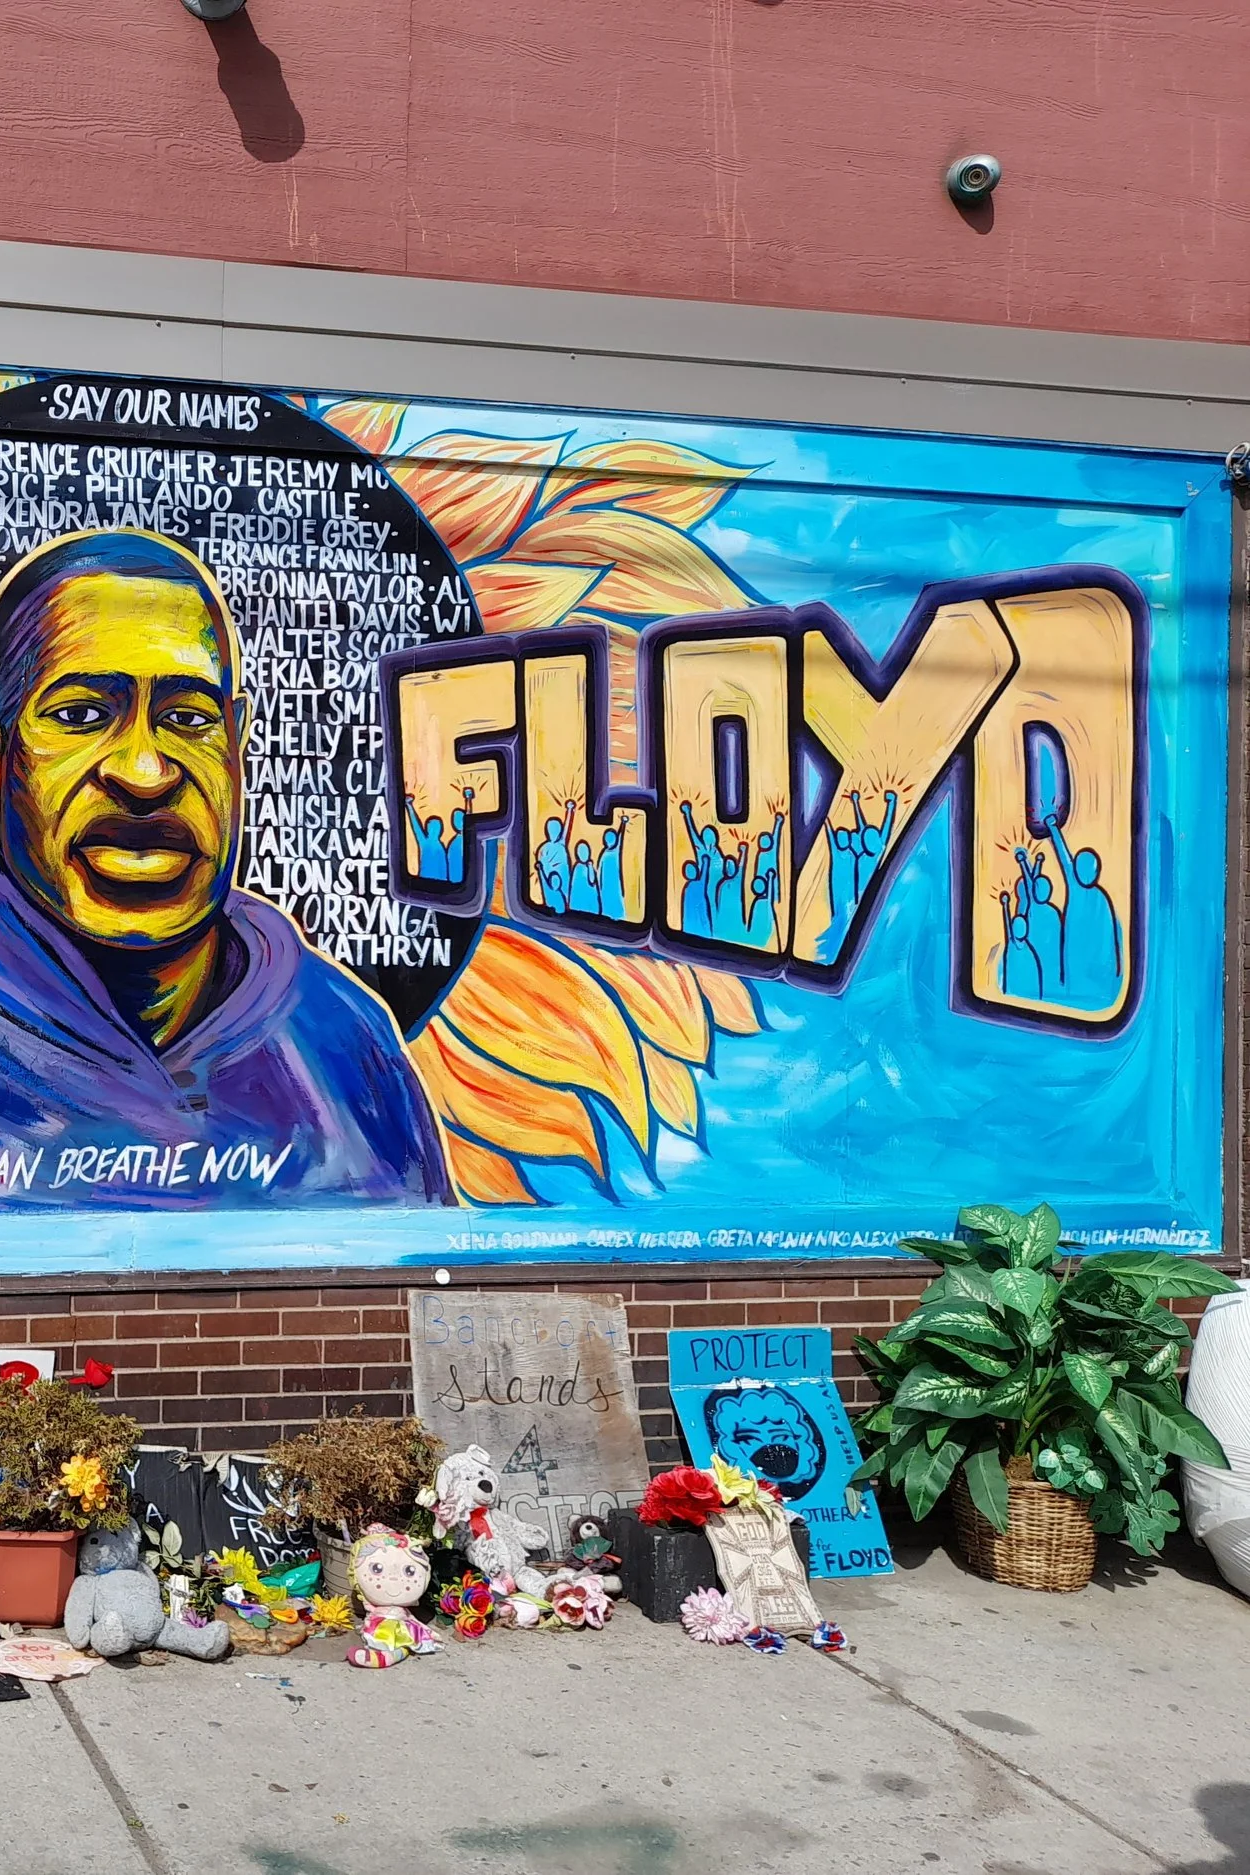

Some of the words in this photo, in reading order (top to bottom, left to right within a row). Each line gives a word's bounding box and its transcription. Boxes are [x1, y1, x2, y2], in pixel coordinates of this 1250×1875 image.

[49, 384, 113, 423] SAY
[115, 386, 172, 427] OUR
[180, 393, 261, 431] NAMES
[87, 446, 217, 486] CRUTCHER
[227, 455, 339, 490] JEREMY
[86, 475, 232, 511] PHILANDO
[257, 487, 361, 521] CASTILE
[102, 502, 189, 537] JAMES
[211, 511, 319, 545] FREDDIE
[322, 520, 391, 551] GREY
[192, 537, 306, 569] TERRANCE
[305, 545, 417, 575] FRANKLIN
[215, 565, 330, 600] BREONNA
[330, 572, 425, 606] TAYLOR
[434, 575, 470, 606] AL
[230, 595, 344, 631] SHANTEL
[348, 601, 421, 633] DAVIS
[432, 604, 471, 633] WI
[236, 626, 344, 661] WALTER
[241, 657, 317, 689] REKIA
[243, 757, 339, 795] JAMAR
[244, 793, 362, 829] TANISHA
[396, 583, 1136, 1026] FLOYD
[244, 826, 345, 860] TARIKA
[244, 856, 332, 896] ALTON
[317, 933, 452, 968] KATHRYN
[48, 1141, 199, 1190] BREATHE
[199, 1142, 293, 1189] NOW
[707, 1229, 753, 1248] GRETA
[422, 1295, 617, 1348] Bancroft
[690, 1332, 813, 1372] PROTECT
[501, 1424, 559, 1496] 4
[800, 1506, 855, 1524] OTHER
[824, 1547, 890, 1573] FLOYD
